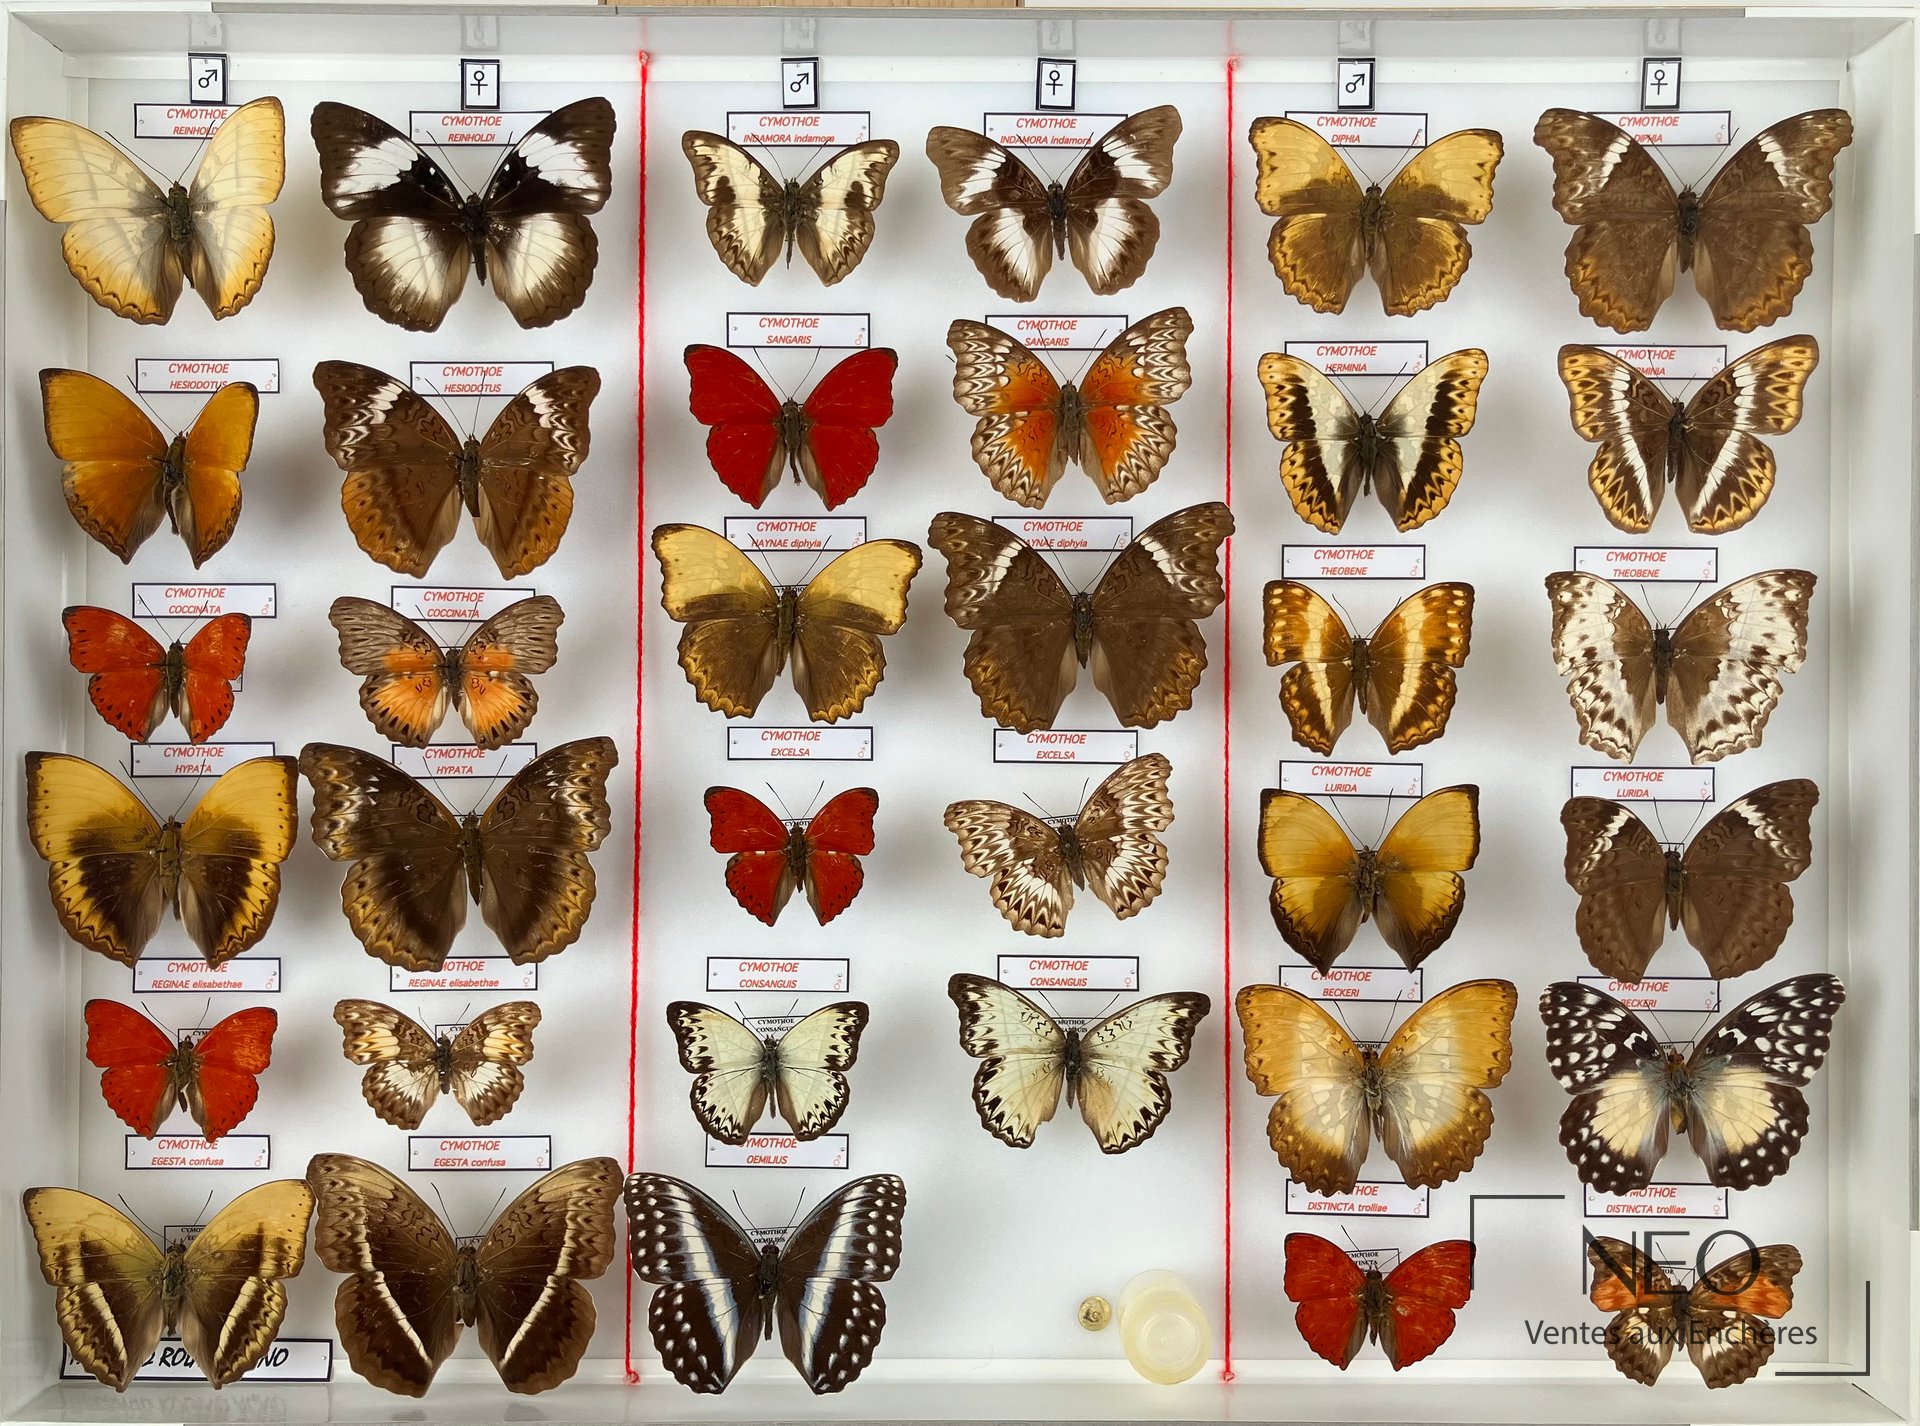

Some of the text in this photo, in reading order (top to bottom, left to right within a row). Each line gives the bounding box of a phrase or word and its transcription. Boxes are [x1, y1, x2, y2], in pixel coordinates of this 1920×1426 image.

[442, 116, 502, 127] CYMOTHOE
[759, 117, 820, 127] CYMOTHOE
[1016, 118, 1077, 128] CYMOTHOE
[1316, 117, 1377, 127] CYMOTHOE
[1619, 116, 1679, 127] CYMOTHOE
[743, 134, 834, 143] INDAMORA indamora
[1000, 135, 1091, 145] INDAMORA indamora
[1331, 134, 1360, 143] DIPHIA
[759, 318, 819, 328] CYMOTHOE
[1017, 320, 1077, 330] CYMOTHOE
[767, 335, 811, 344] SANGARIS
[1025, 338, 1069, 346] SANGARIS
[1316, 346, 1377, 356] CYMOTHOE
[1615, 350, 1676, 360] CYMOTHOE
[169, 363, 229, 374] CYMOTHOE
[443, 366, 503, 377] CYMOTHOE
[1326, 363, 1367, 372] HERMINIA
[444, 384, 501, 392] HESIODOTUS
[756, 522, 817, 532] CYMOTHOE
[1023, 521, 1083, 532] CYMOTHOE
[751, 539, 788, 548] HAYNAE
[1314, 549, 1374, 560] CYMOTHOE
[1606, 552, 1667, 562] CYMOTHOE
[1321, 567, 1368, 576] THEOBENE
[1613, 569, 1659, 577] THEOBENE
[165, 588, 226, 598] CYMOTHOE
[424, 592, 484, 602] CYMOTHOE
[169, 605, 221, 614] COCCINATA
[427, 609, 480, 617] COCCINATA
[761, 731, 821, 741] CYMOTHOE
[1027, 734, 1086, 744] CYMOTHOE
[164, 747, 224, 757] CYMOTHOE
[425, 748, 485, 758] CYMOTHOE
[771, 748, 810, 756] EXCELSA
[1037, 750, 1075, 759] EXCELSA
[175, 764, 212, 773] HYPATA
[437, 766, 473, 774] HYPATA
[1312, 766, 1372, 776] CYMOTHOE
[1603, 772, 1664, 782] CYMOTHOE
[1325, 783, 1357, 792] LURIDA
[1617, 789, 1649, 797] LURIDA
[739, 962, 799, 972] CYMOTHOE
[1029, 961, 1089, 971] CYMOTHOE
[152, 979, 242, 988] REGINAE elisabethae
[408, 977, 499, 987] REGINAE elisabethae
[740, 980, 797, 988] CONSANGUIS
[1030, 978, 1087, 987] CONSANGUIS
[1323, 988, 1360, 997] BECKERI
[440, 1141, 500, 1151] CYMOTHOE
[740, 1138, 798, 1148] YMOTHOE
[152, 1156, 224, 1166] EGESTA confusa
[434, 1157, 506, 1167] EGESTA confusa
[747, 1155, 788, 1164] OEMILIUS
[1308, 1202, 1355, 1211] DISTINCTA
[1606, 1205, 1654, 1213] DISTINCTA
